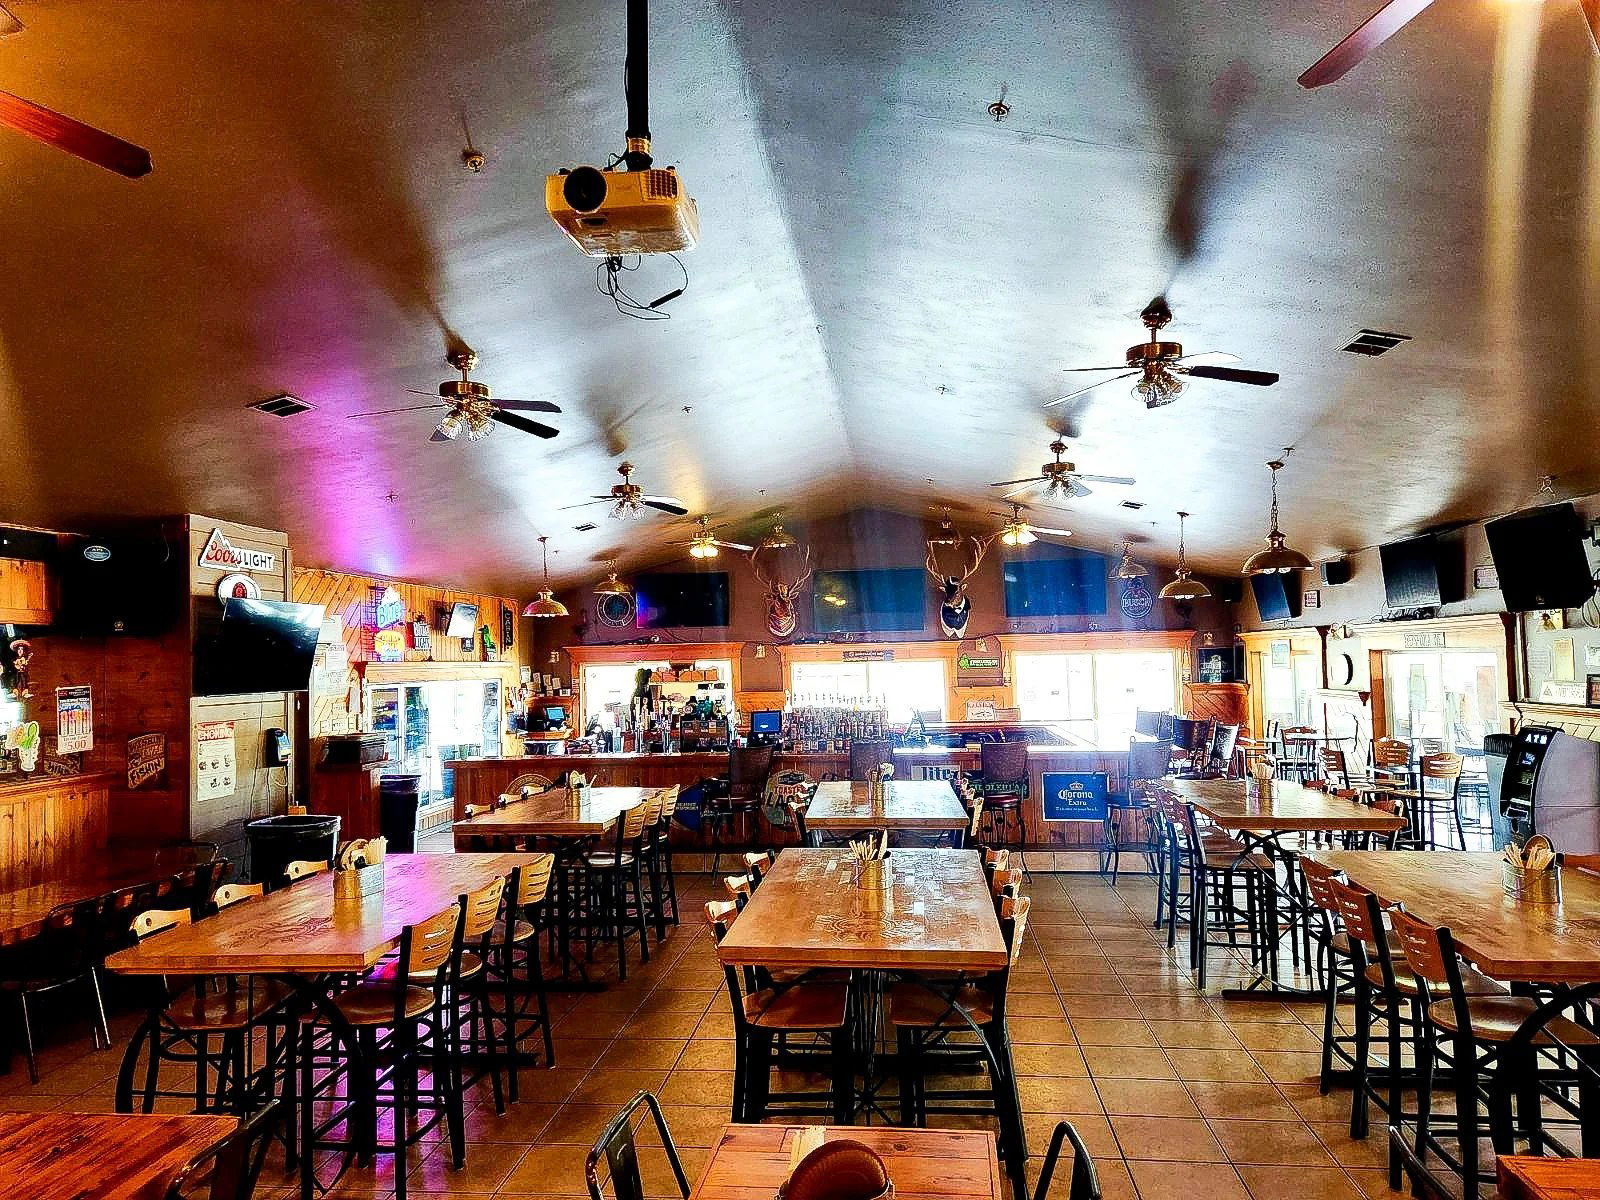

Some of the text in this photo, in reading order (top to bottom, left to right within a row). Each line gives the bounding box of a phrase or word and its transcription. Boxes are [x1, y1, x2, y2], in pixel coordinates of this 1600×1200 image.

[206, 541, 272, 569] Coors LIGHT
[1525, 733, 1548, 745] ATM
[1058, 789, 1094, 801] Corona
